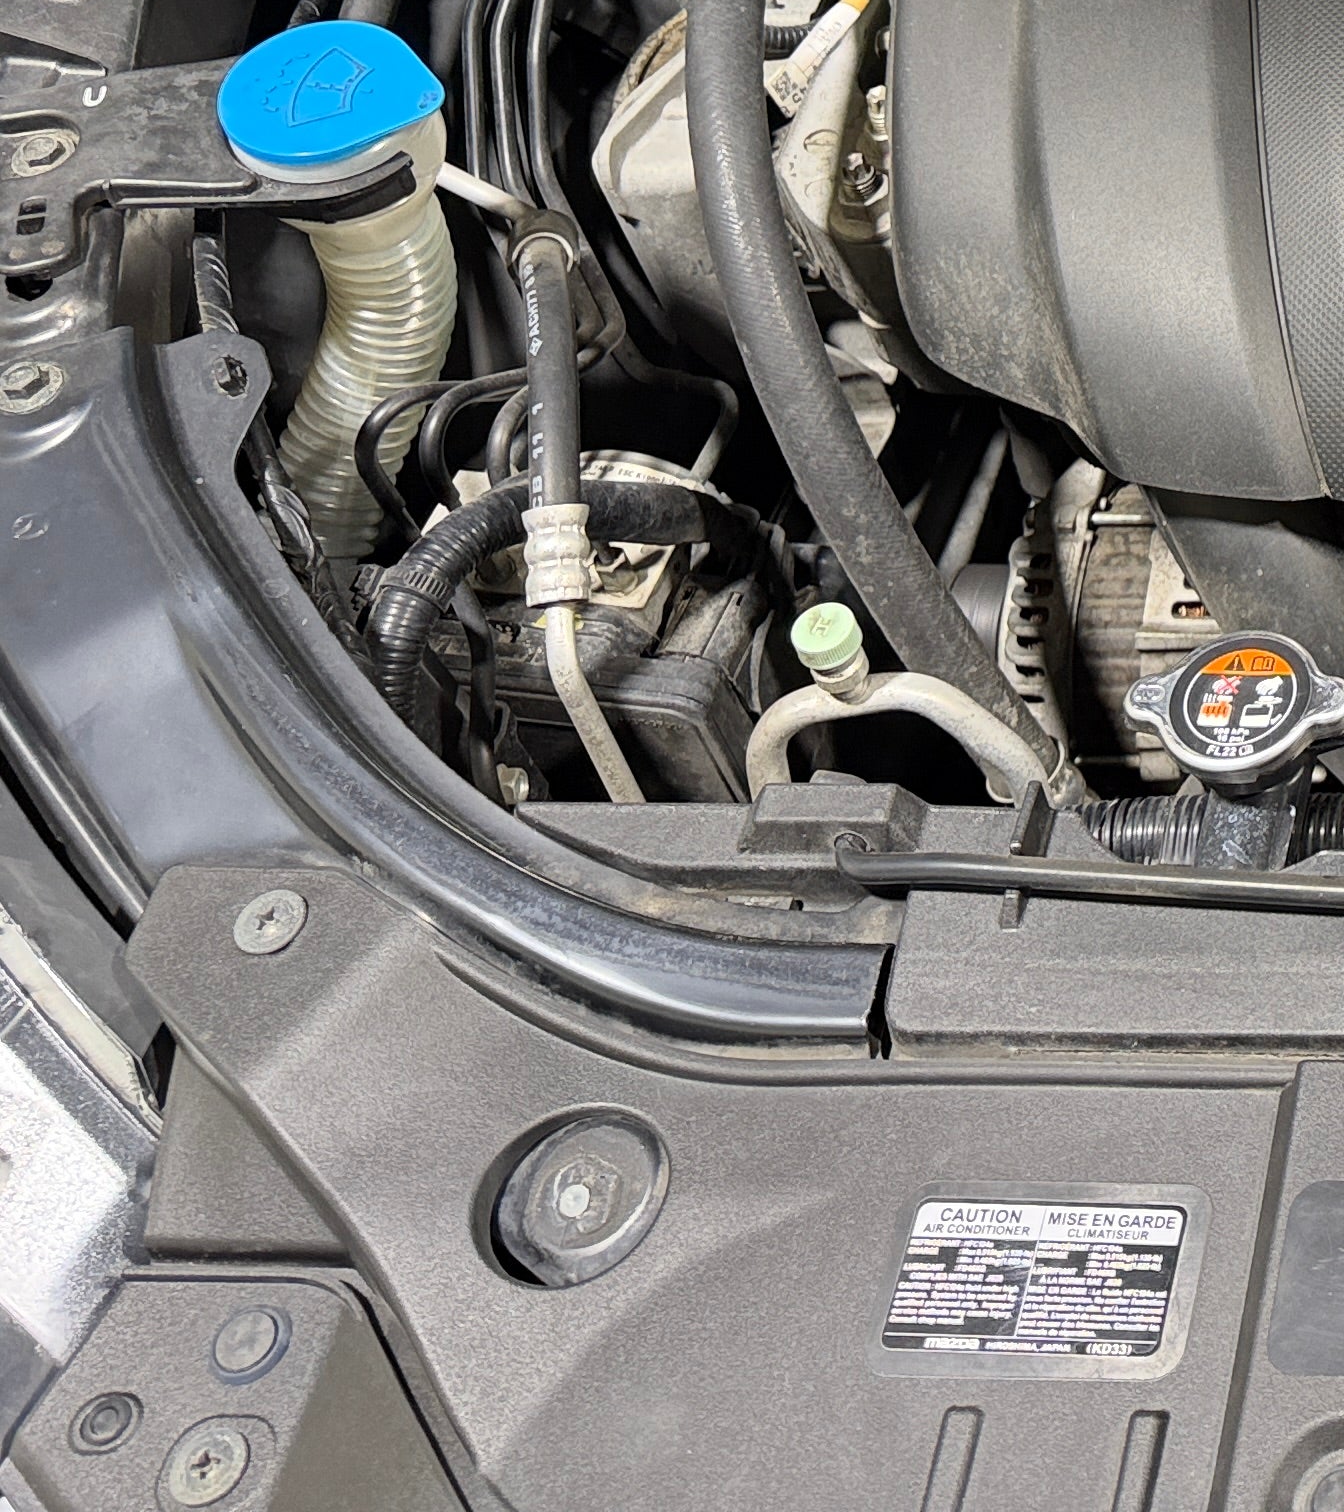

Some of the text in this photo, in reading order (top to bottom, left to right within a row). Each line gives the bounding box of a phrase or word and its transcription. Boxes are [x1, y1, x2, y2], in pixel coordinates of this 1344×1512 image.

[1206, 744, 1237, 757] FL22
[940, 1209, 1022, 1223] CAUTION
[1048, 1213, 1177, 1230] MISE EN GARDE
[923, 1224, 1030, 1236] AIR CONDITIONER
[1067, 1229, 1148, 1241] CLIMATISEUR
[923, 1338, 980, 1349] mazda
[1086, 1343, 1132, 1355] (KD33)
